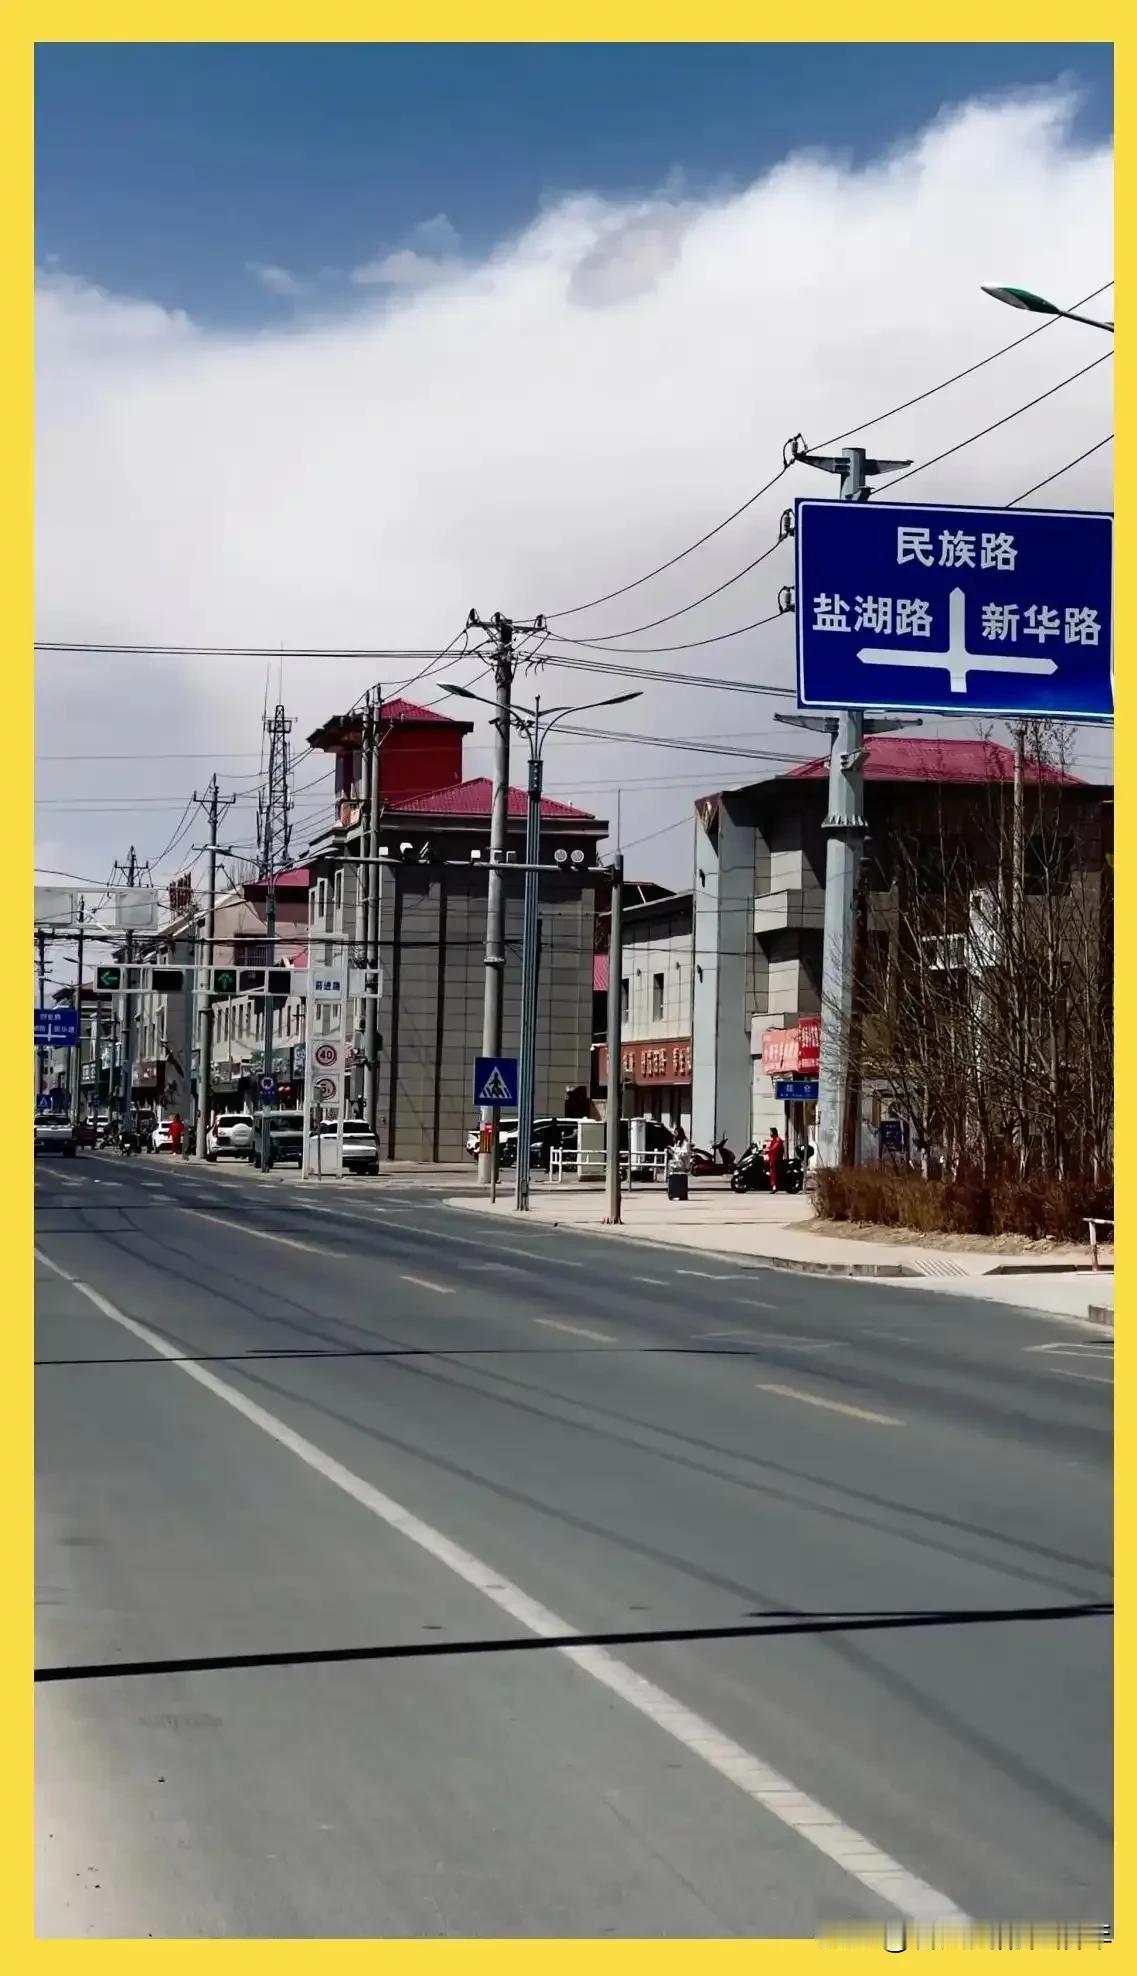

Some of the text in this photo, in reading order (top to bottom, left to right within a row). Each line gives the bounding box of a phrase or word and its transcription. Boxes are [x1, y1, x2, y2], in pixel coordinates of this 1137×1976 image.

[895, 526, 1018, 571] 民族路
[812, 593, 934, 638] 盐湖路
[981, 602, 1102, 646] 新华路
[319, 1050, 333, 1060] 40
